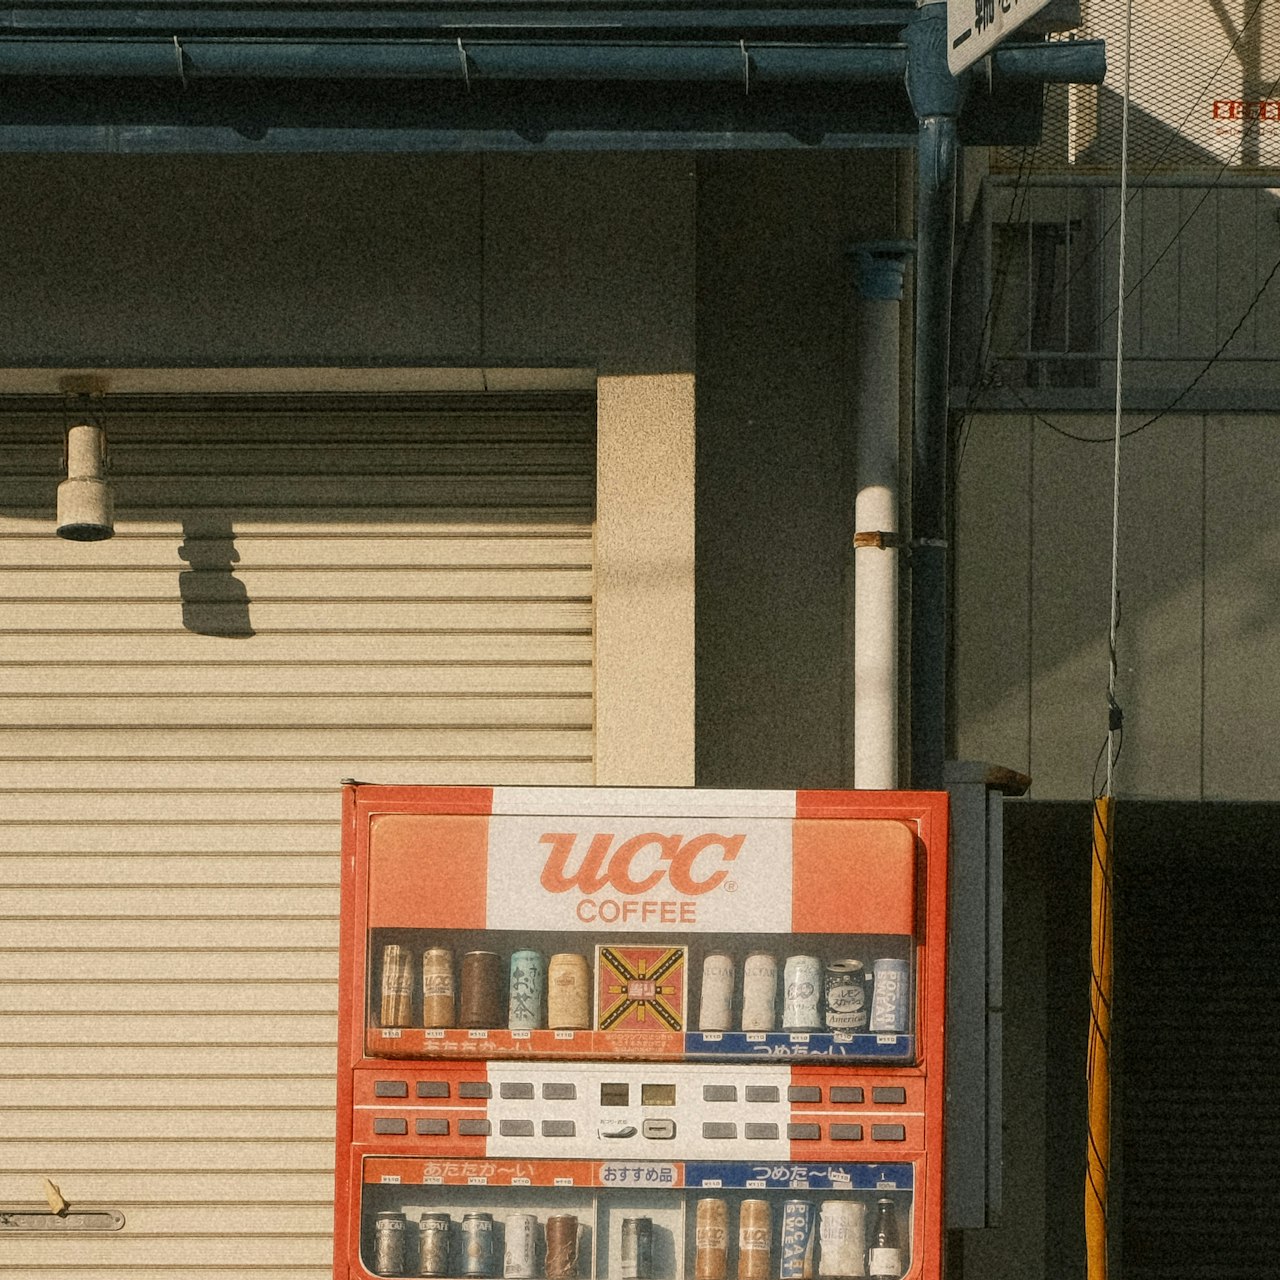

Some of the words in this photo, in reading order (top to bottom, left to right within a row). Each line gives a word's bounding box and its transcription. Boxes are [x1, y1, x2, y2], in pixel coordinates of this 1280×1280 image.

[576, 898, 697, 923] COFFEE
[885, 970, 897, 1030] POCARI
[603, 1166, 673, 1183] おすすめ品
[783, 1204, 796, 1270] SWEAT
